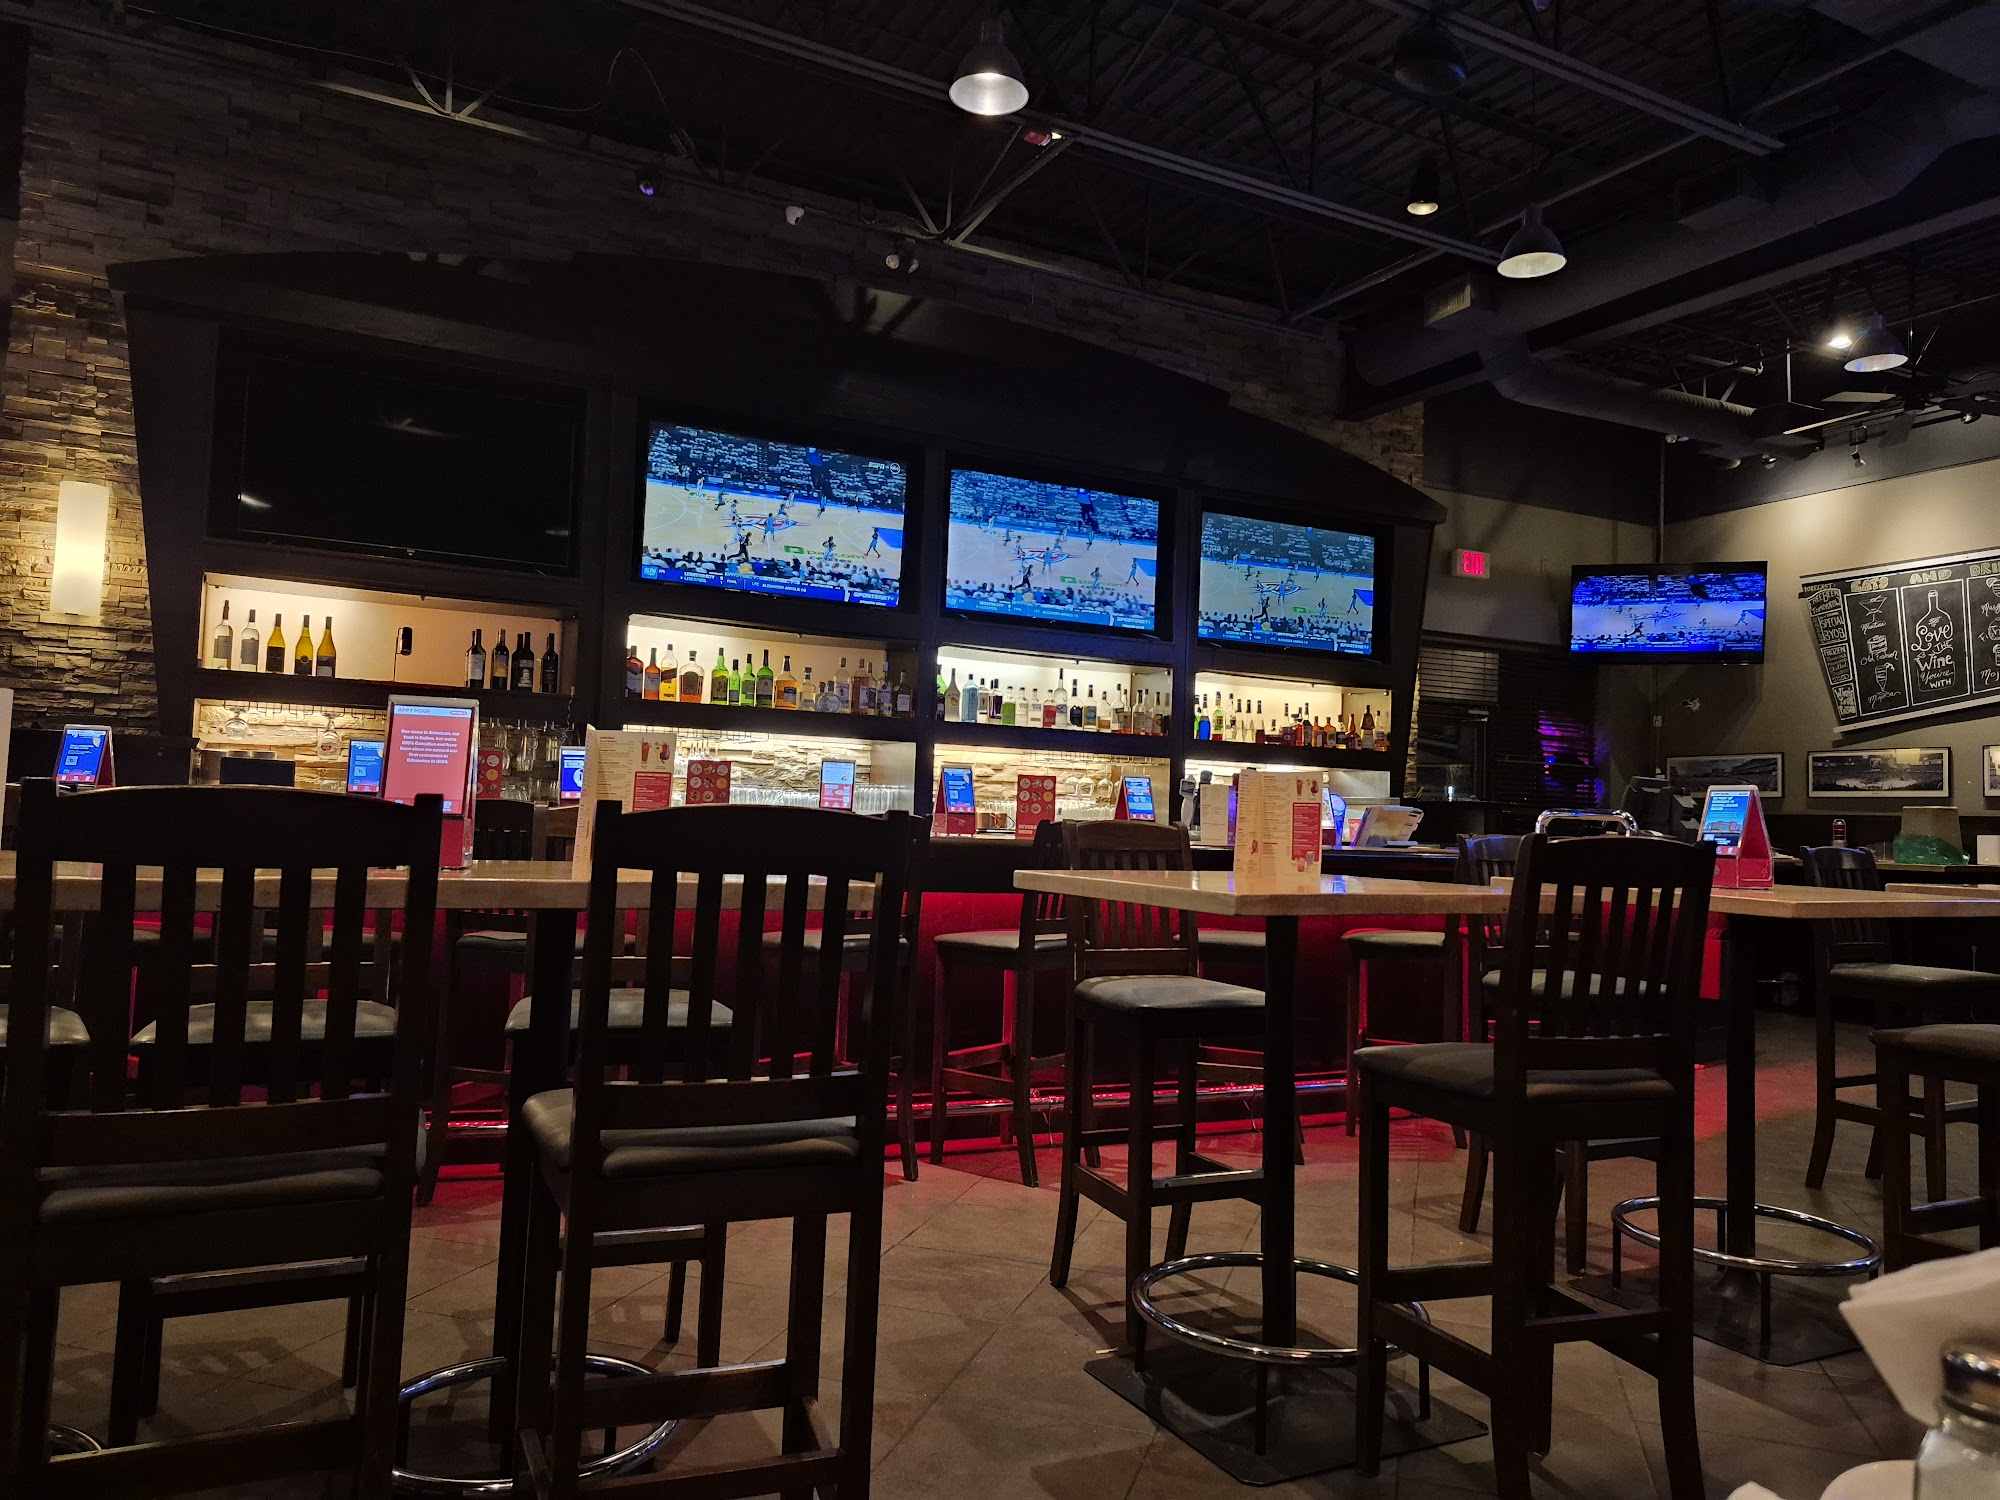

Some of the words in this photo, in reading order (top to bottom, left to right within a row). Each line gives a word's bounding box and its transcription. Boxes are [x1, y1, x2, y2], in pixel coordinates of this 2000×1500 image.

[1850, 576, 1888, 592] EATS
[1909, 569, 1952, 584] AND
[1820, 616, 1845, 628] SPECIAL
[1823, 628, 1846, 640] BYOB
[1910, 624, 1953, 652] Love
[1934, 639, 1952, 652] THE
[1914, 653, 1953, 672] Wine
[1930, 678, 1952, 689] WITH
